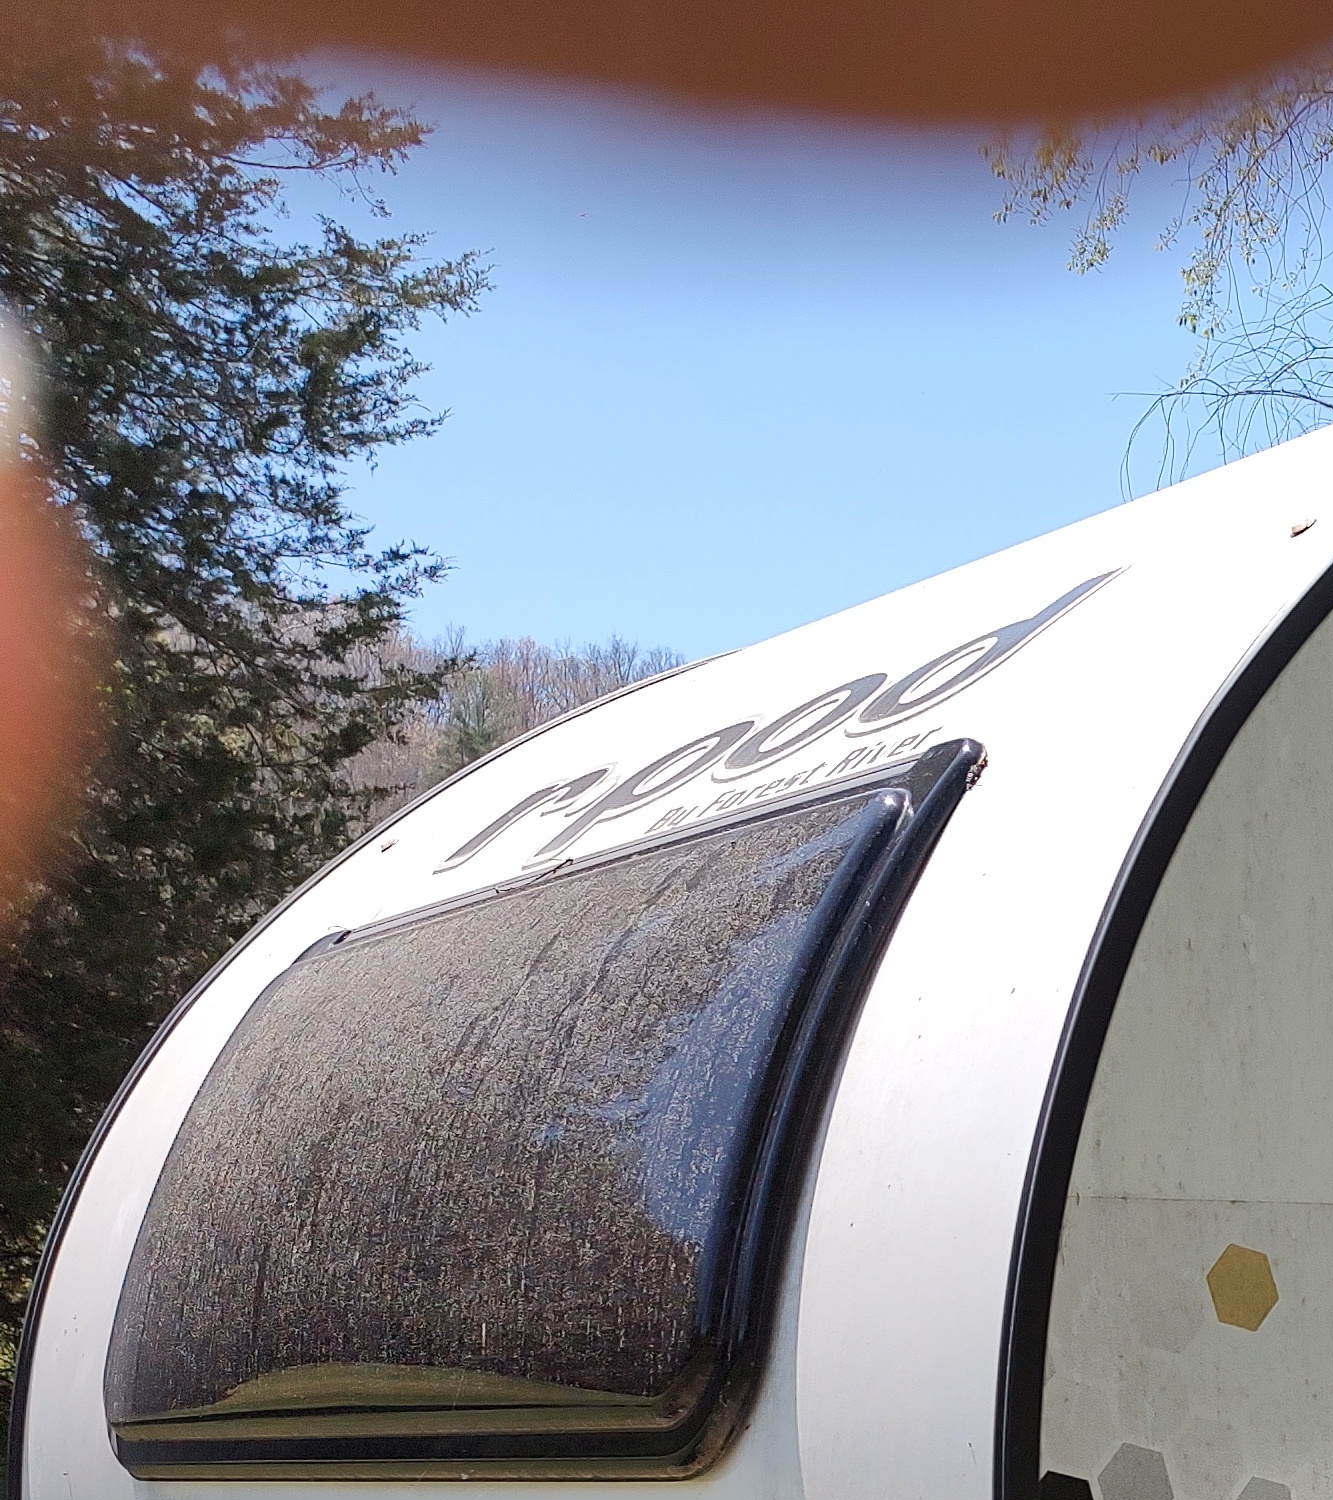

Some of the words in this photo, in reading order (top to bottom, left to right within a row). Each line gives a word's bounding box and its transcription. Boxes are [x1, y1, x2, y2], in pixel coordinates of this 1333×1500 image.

[645, 805, 698, 834] By
[697, 761, 827, 818] Forest
[824, 726, 943, 777] River
